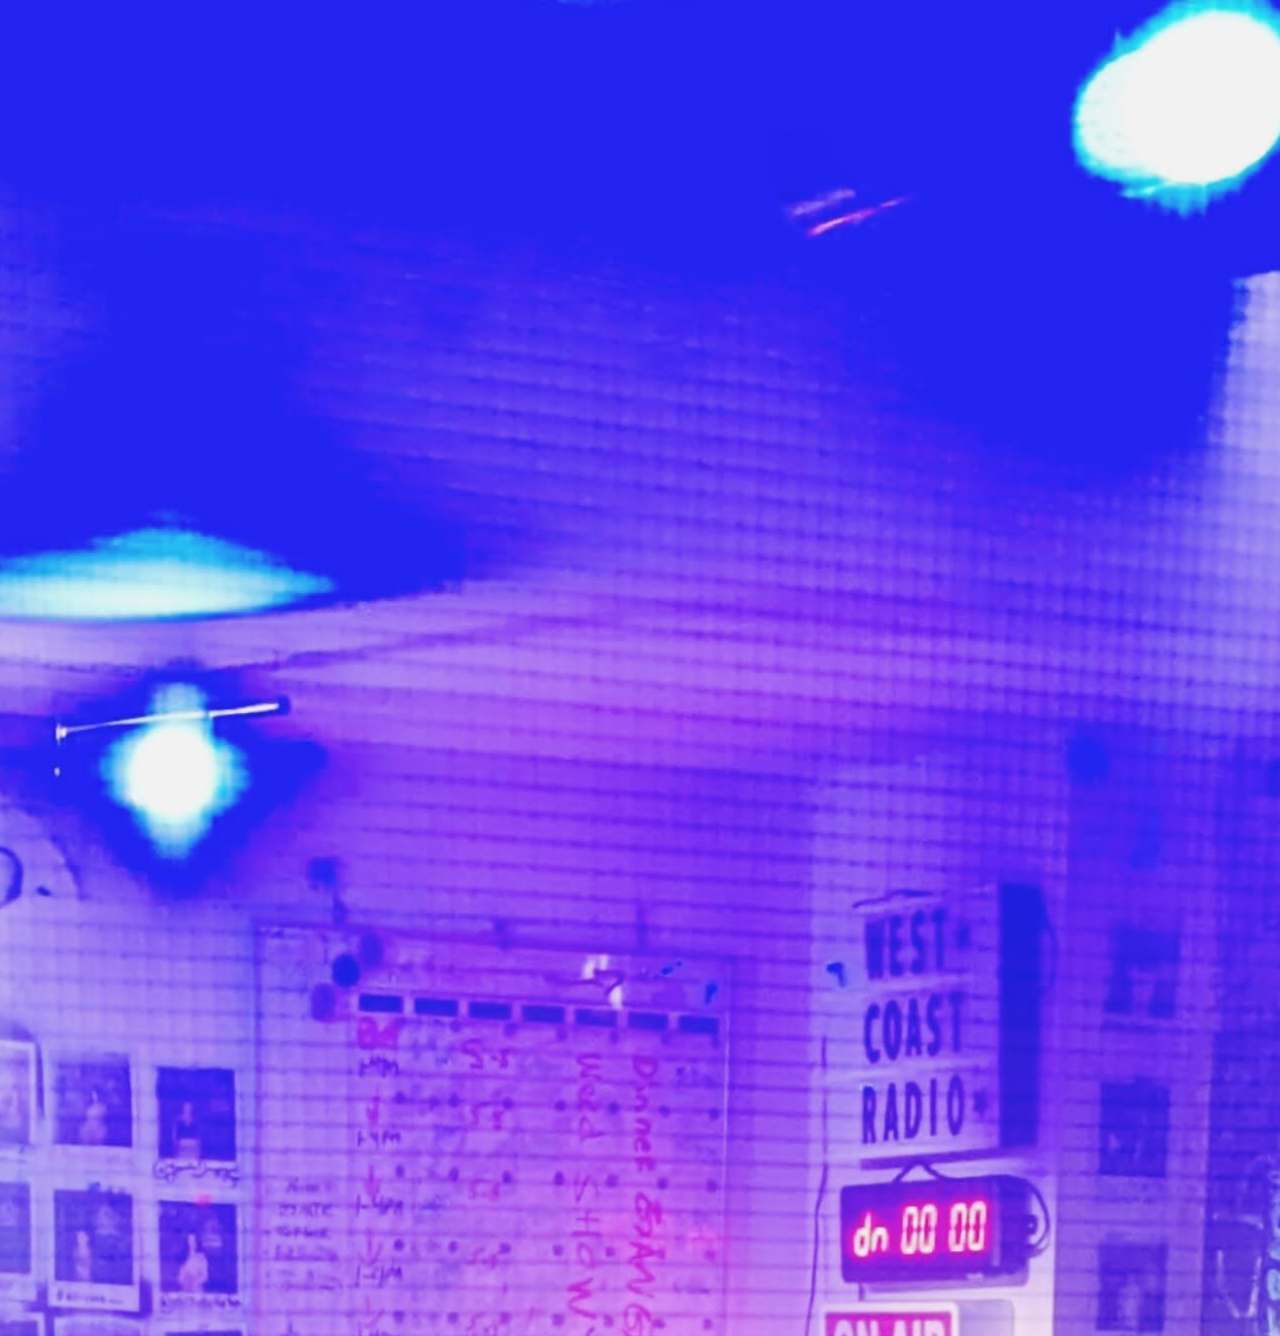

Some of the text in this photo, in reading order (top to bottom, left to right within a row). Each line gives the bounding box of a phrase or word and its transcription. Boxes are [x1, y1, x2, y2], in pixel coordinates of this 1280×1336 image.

[864, 908, 946, 980] WEST
[863, 991, 964, 1063] COAST
[862, 1074, 966, 1145] RADIO
[901, 1203, 938, 1255] 00
[949, 1201, 987, 1252] 00
